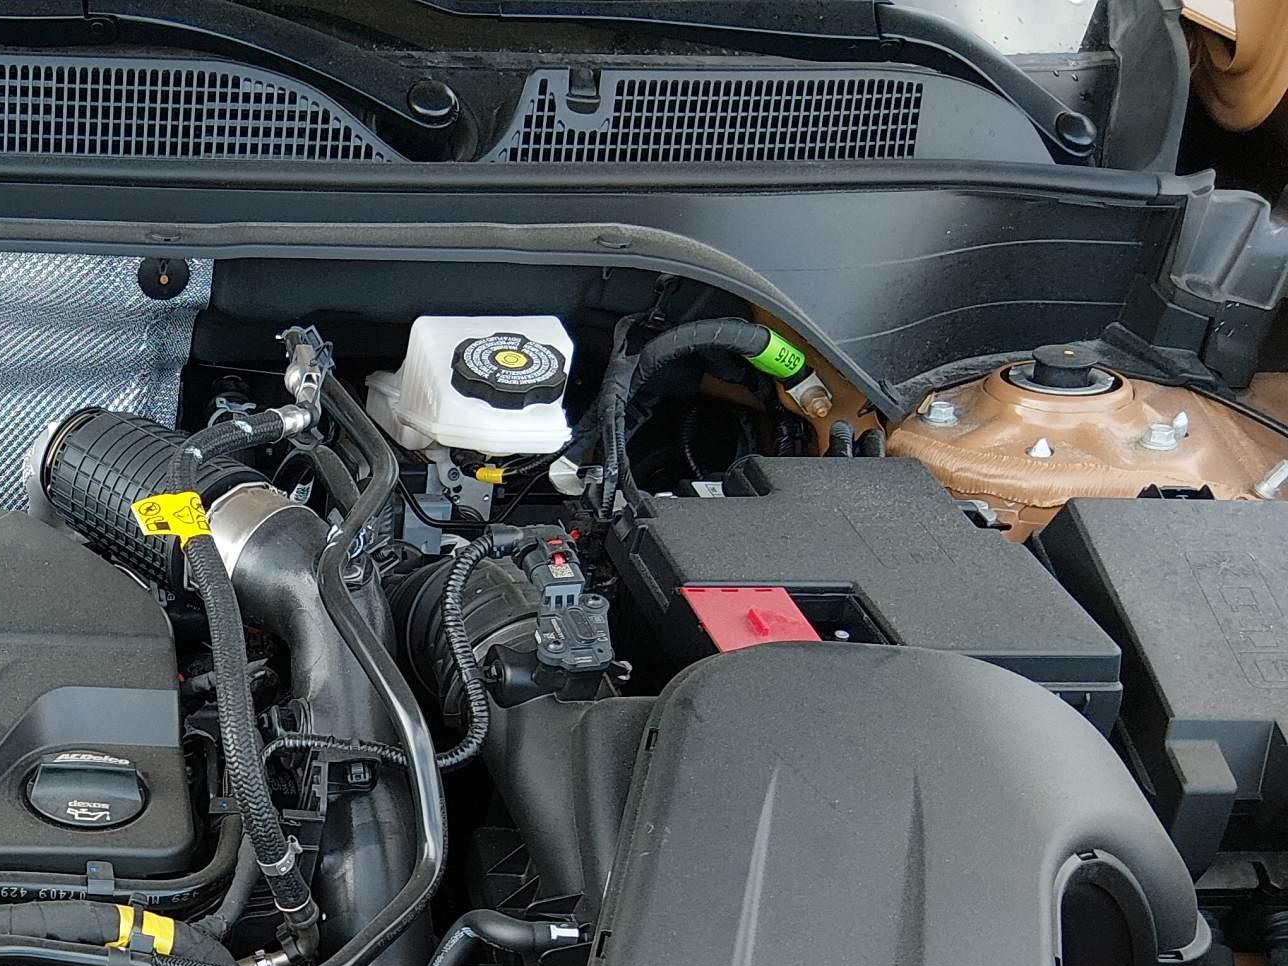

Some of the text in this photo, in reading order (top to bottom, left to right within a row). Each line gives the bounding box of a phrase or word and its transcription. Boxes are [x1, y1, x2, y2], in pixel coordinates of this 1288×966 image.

[774, 347, 801, 370] 5515
[53, 753, 130, 766] ACDelco
[68, 800, 110, 809] dexos
[0, 887, 28, 898] 429
